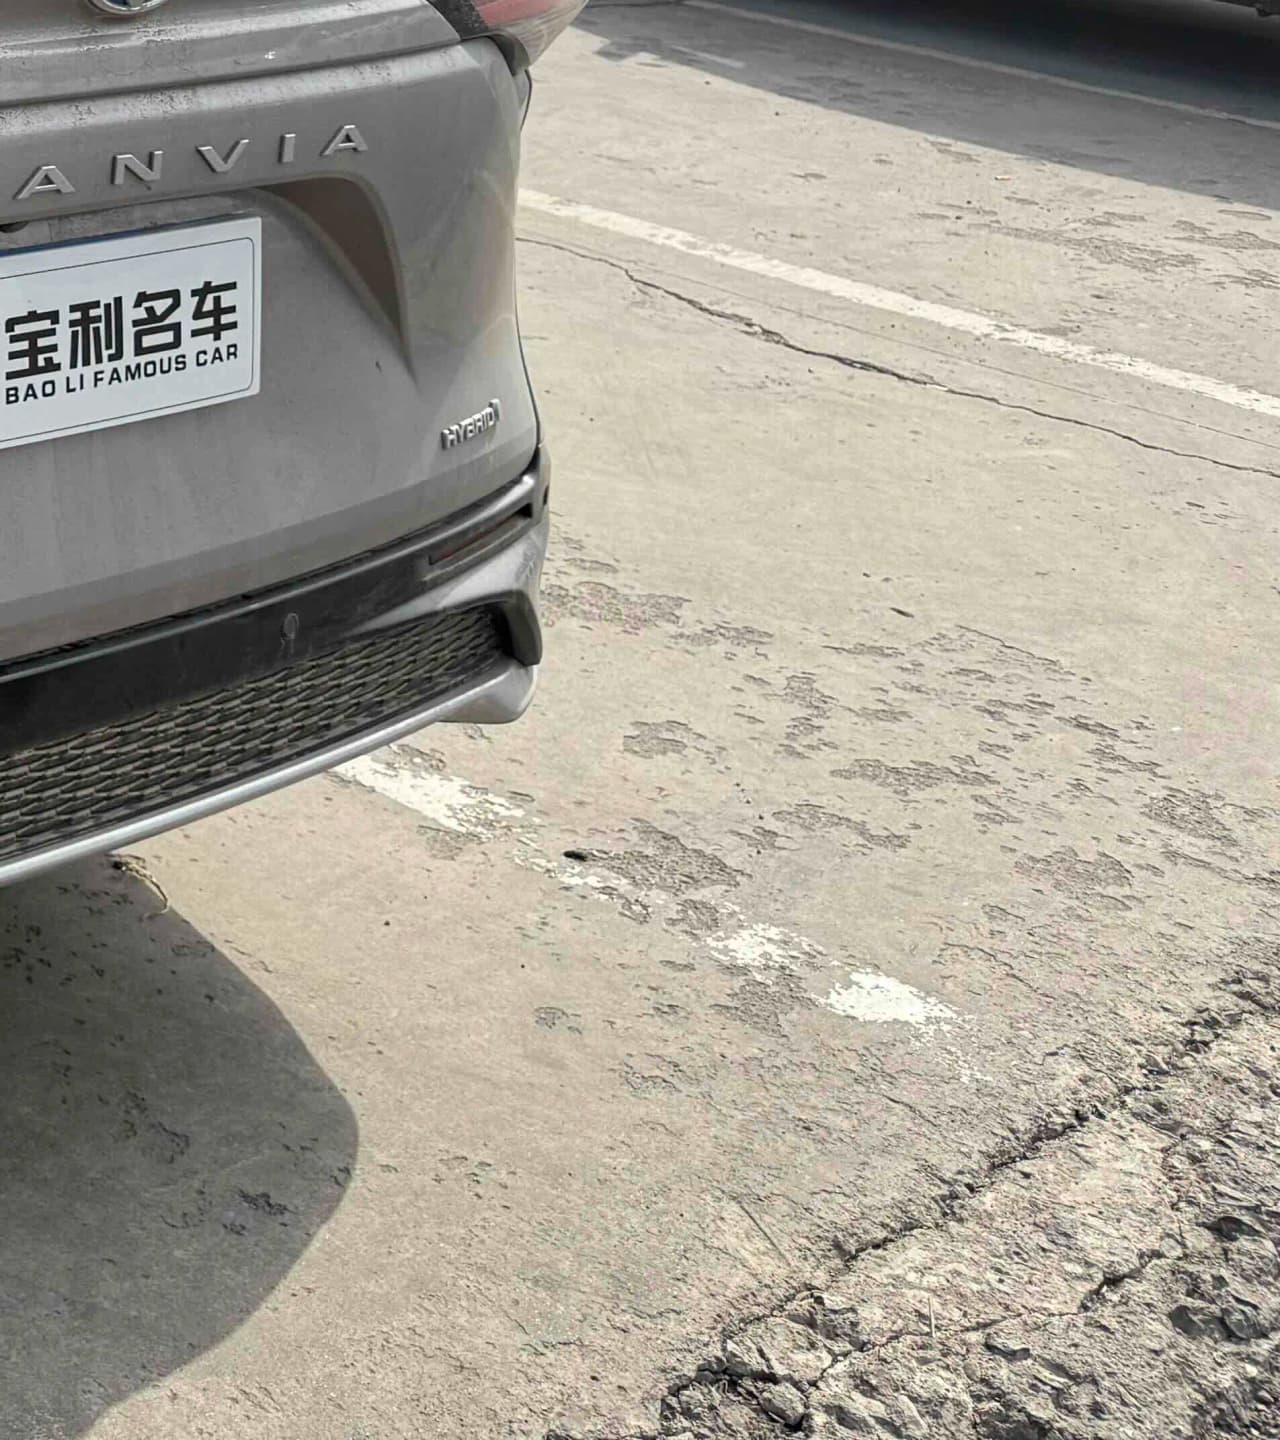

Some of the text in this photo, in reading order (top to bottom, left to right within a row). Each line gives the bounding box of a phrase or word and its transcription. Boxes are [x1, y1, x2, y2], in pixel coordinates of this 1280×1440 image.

[5, 281, 238, 381] 宝利名车
[5, 343, 238, 405] BAO LI FAMOUS CAR
